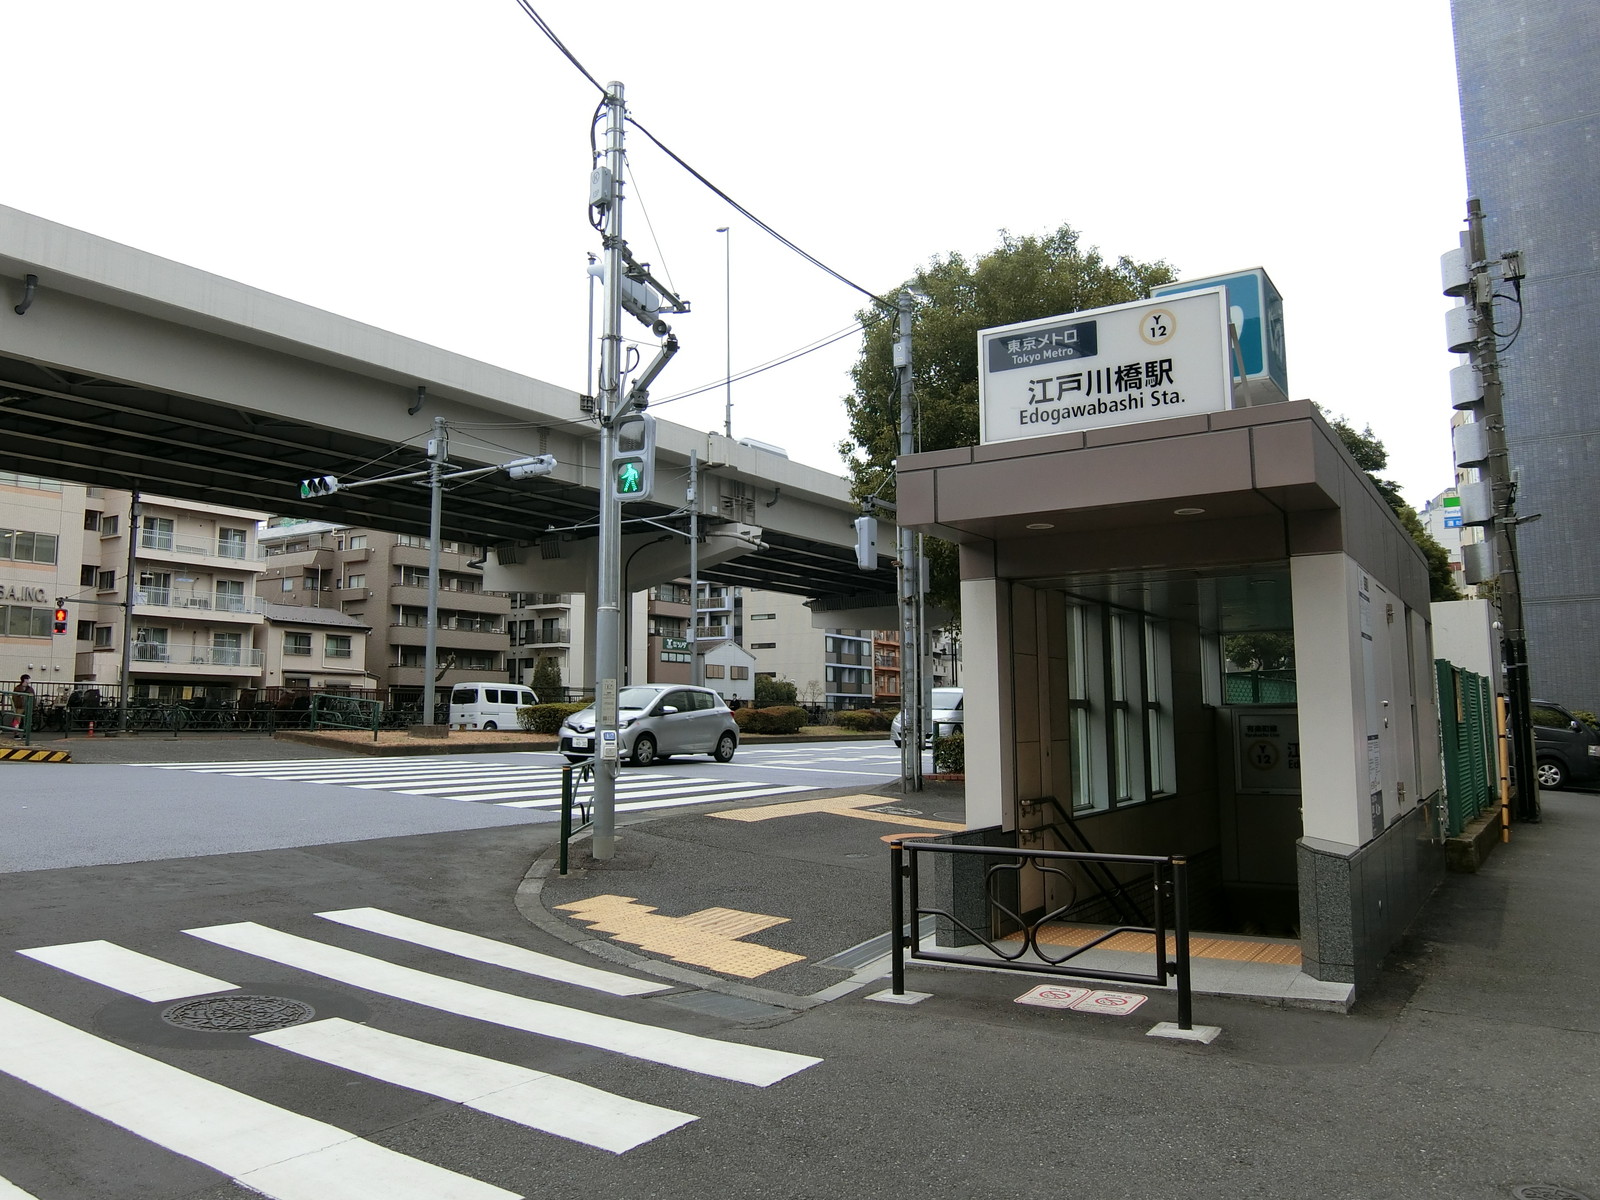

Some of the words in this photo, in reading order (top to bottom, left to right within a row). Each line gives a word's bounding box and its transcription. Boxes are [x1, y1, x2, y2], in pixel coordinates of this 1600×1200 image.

[1152, 314, 1162, 325] Y
[1150, 325, 1167, 338] 12
[1007, 329, 1078, 354] 東京メトロ
[1012, 353, 1041, 364] Tokyo
[1043, 347, 1074, 360] Metro
[1028, 358, 1174, 405] 江戸川橋駅
[1019, 392, 1145, 425] Edogawabashi
[1151, 390, 1185, 407] Sta.
[1259, 745, 1266, 753] Y
[1257, 755, 1271, 764] 12
